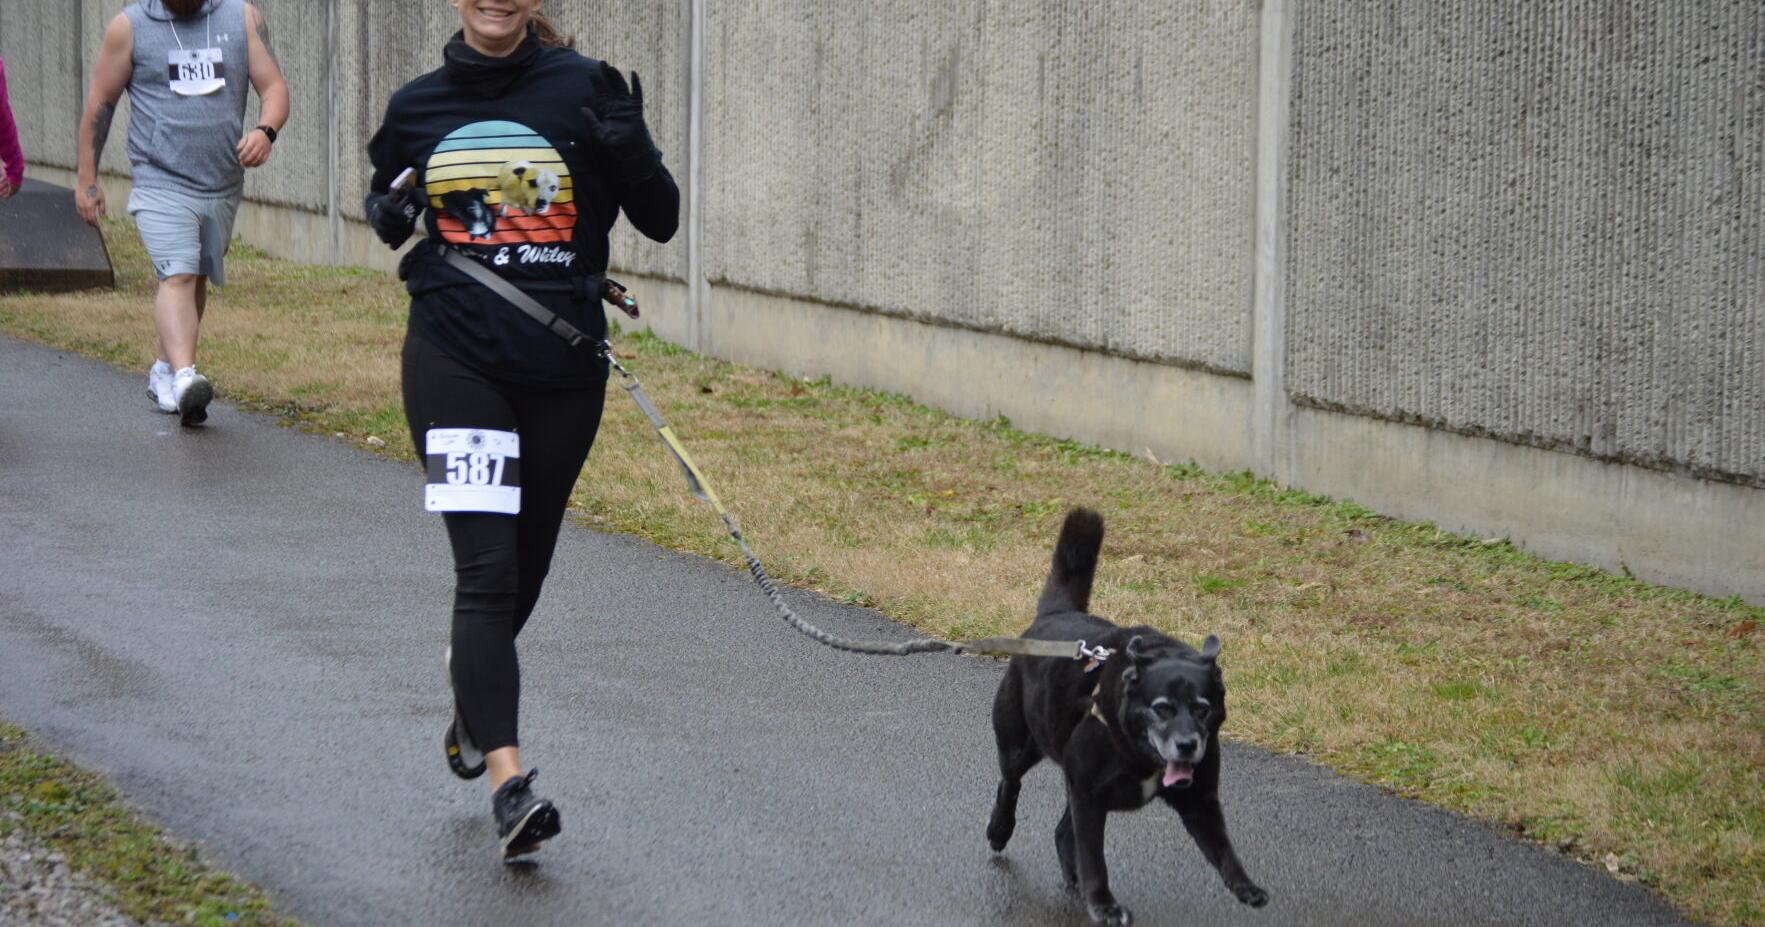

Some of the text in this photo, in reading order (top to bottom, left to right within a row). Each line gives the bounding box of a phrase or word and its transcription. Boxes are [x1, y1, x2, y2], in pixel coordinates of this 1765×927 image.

[179, 62, 214, 80] 630
[493, 246, 510, 265] &
[446, 452, 505, 486] 587
